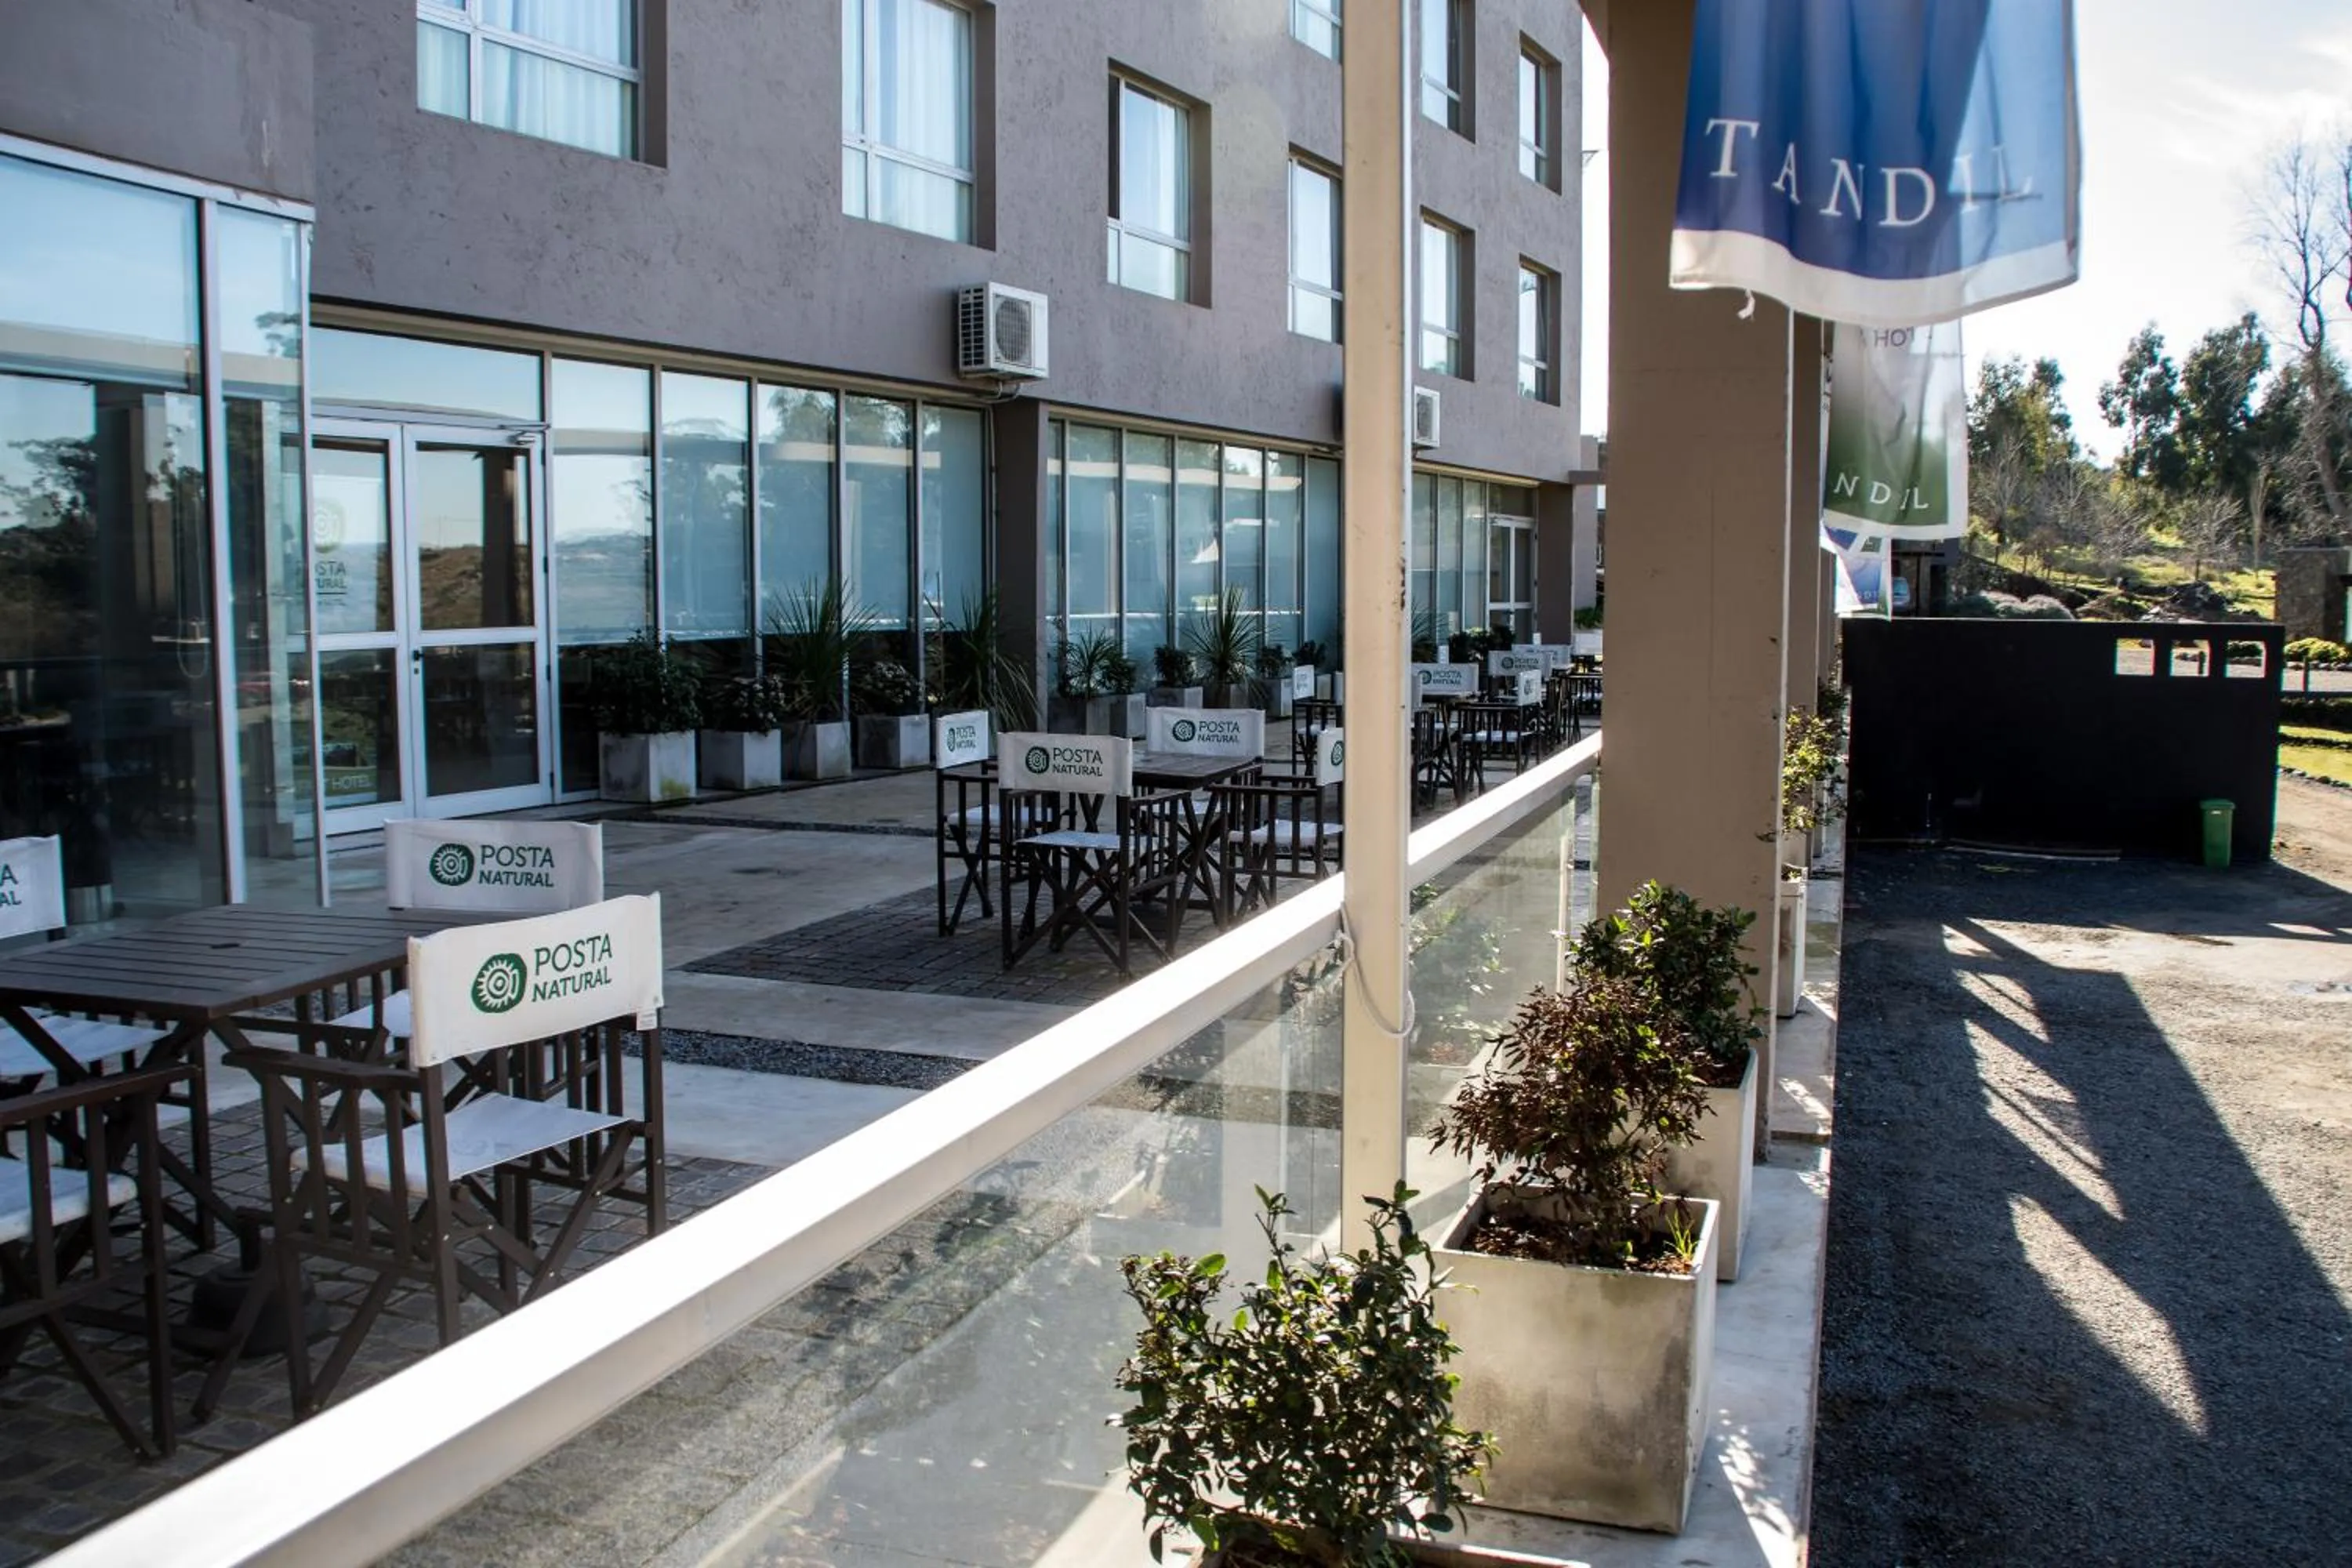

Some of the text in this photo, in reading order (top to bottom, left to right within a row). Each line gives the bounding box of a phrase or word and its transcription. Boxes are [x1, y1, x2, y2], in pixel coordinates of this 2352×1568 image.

[1704, 118, 2034, 228] TANDIL
[1199, 720, 1241, 734] POSTA
[1197, 734, 1240, 743] NATURAL
[1052, 747, 1103, 764] POSTA
[1051, 764, 1103, 777] NATURAL
[480, 844, 555, 869] POSTA
[478, 869, 554, 887] NATURAL
[534, 933, 613, 976] POSTA
[531, 965, 612, 1003] NATURAL
